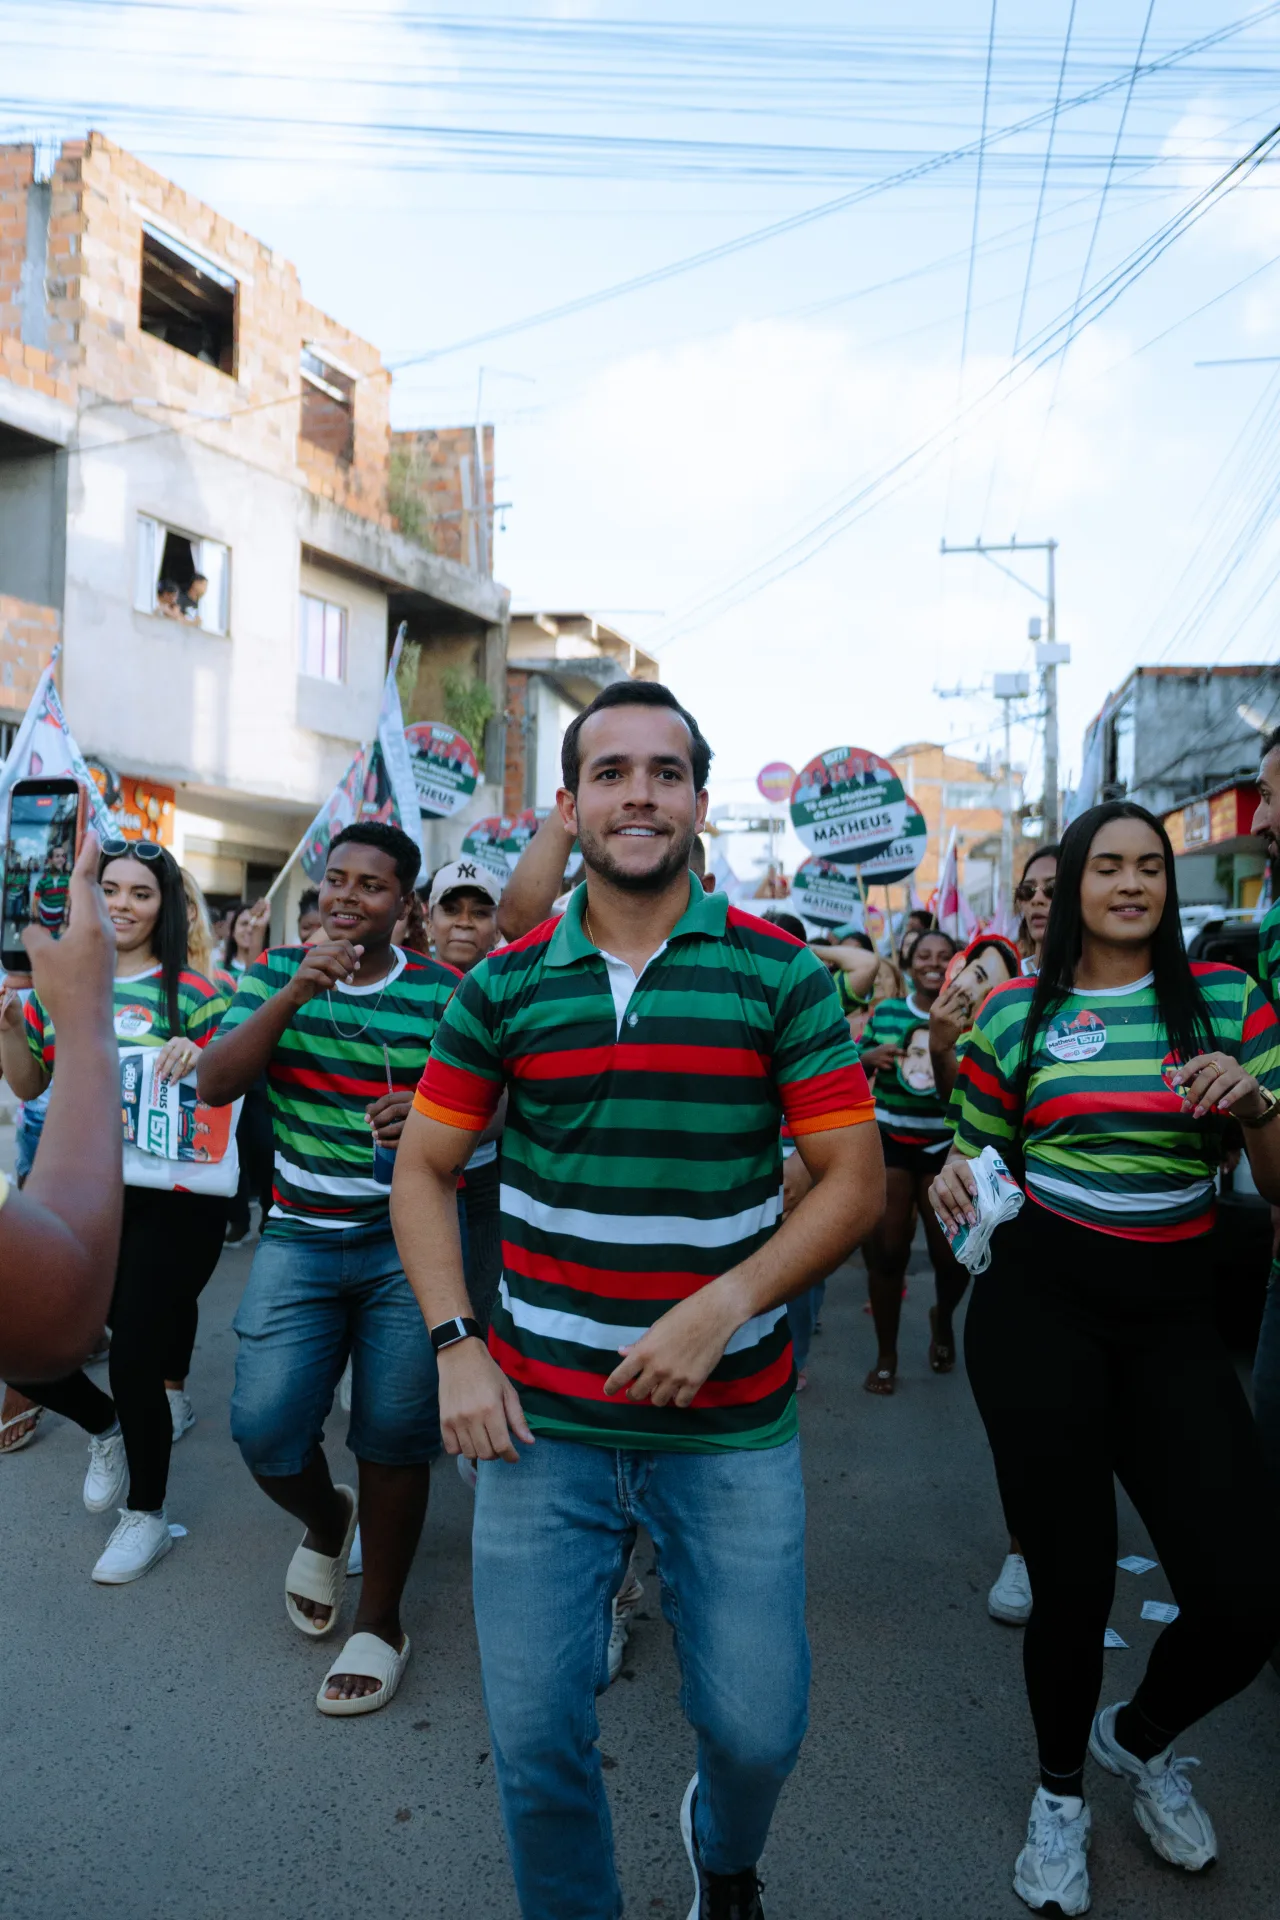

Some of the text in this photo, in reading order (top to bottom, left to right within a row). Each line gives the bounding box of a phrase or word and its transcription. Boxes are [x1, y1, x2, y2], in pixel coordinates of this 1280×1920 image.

[813, 811, 892, 842] MATHEUS
[457, 863, 477, 879] NY
[802, 892, 854, 914] MATHEUS
[1048, 1036, 1076, 1049] Matheus
[159, 1072, 172, 1109] heus
